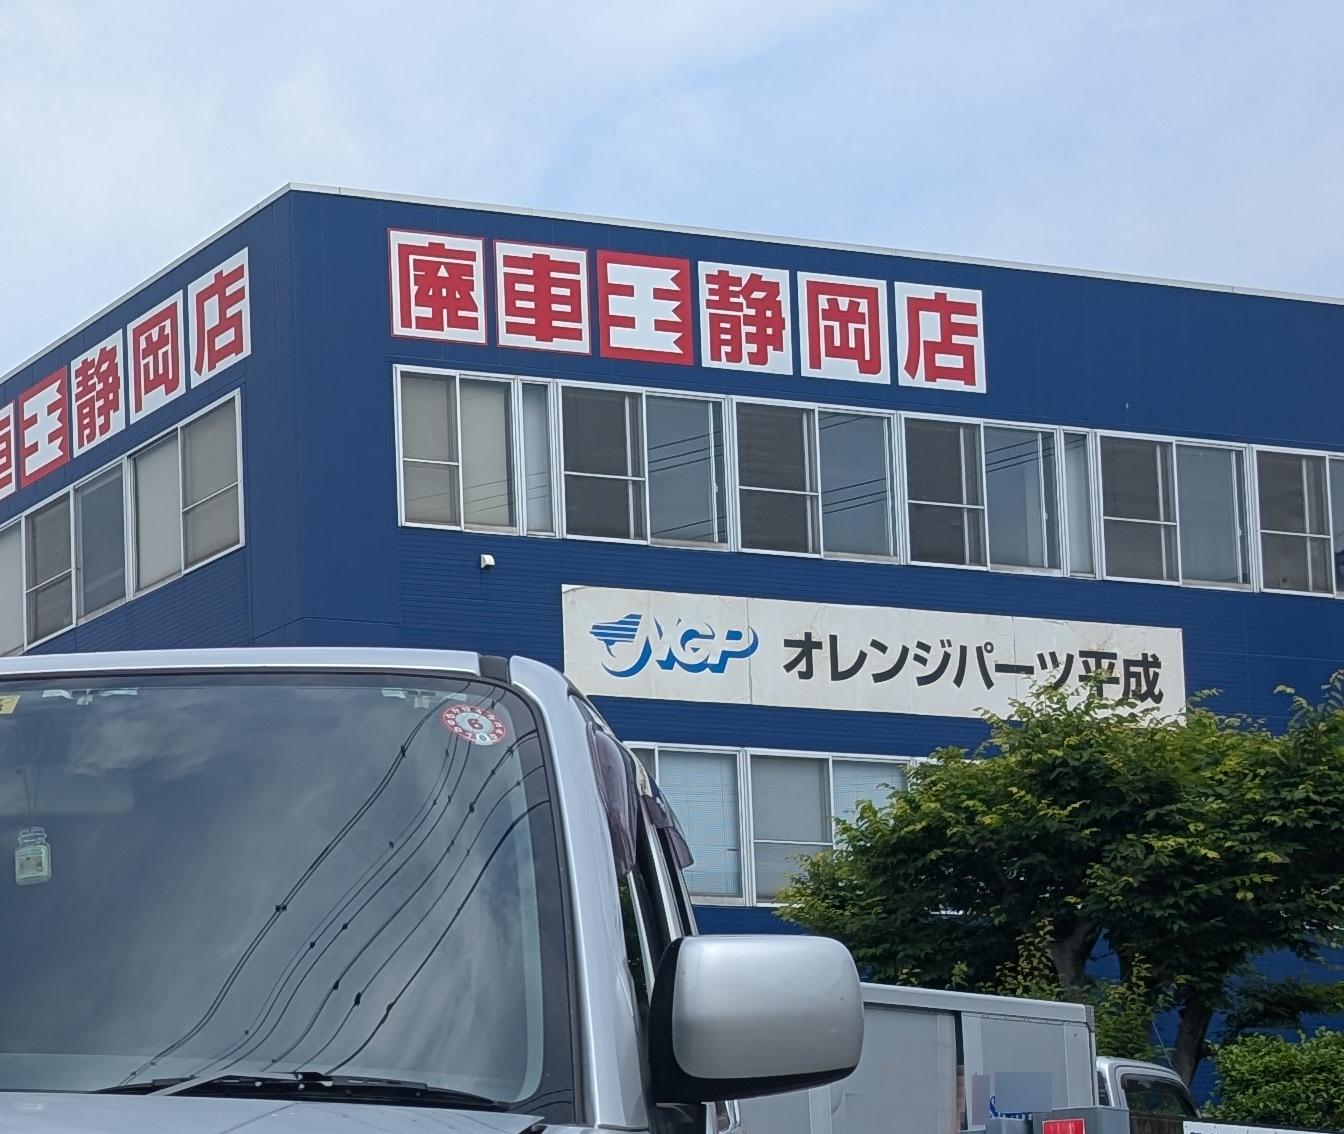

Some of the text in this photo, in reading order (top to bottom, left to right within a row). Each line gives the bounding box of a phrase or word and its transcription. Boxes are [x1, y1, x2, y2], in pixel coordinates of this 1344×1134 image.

[396, 242, 980, 387] 廃車王静岡店
[782, 630, 1164, 705] オレンジパーツ平成
